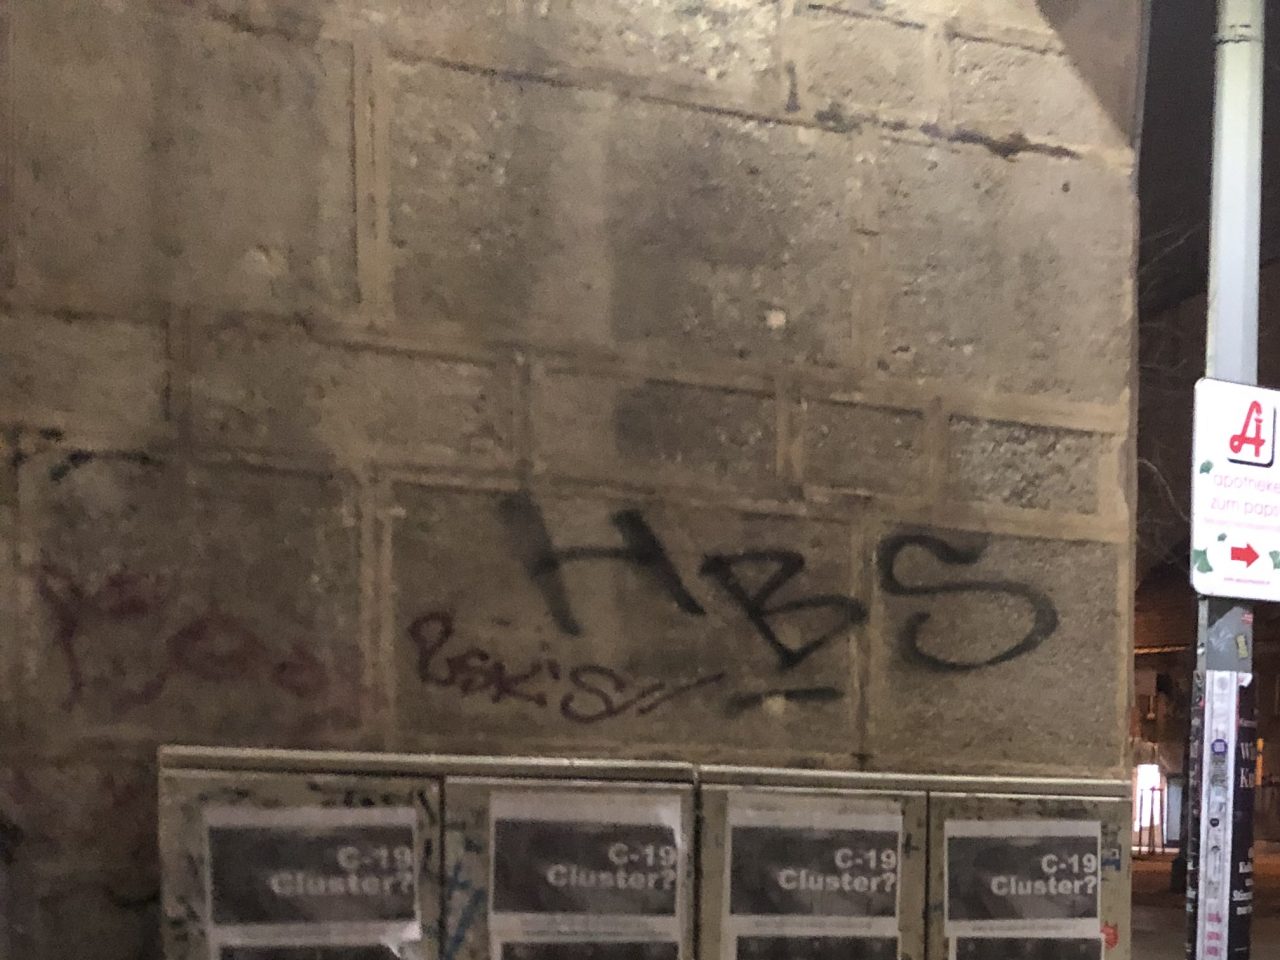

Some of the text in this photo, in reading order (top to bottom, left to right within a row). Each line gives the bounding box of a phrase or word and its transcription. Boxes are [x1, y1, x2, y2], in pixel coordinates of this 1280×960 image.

[1210, 496, 1239, 511] zum
[336, 845, 414, 870] C-19
[607, 842, 678, 866] C-19
[833, 847, 897, 870] C-19
[1040, 853, 1097, 874] C-19
[268, 868, 415, 897] Cluster?
[546, 863, 678, 891] Cluster?
[777, 866, 898, 891] Cluster?
[990, 875, 1097, 897] Cluster?
